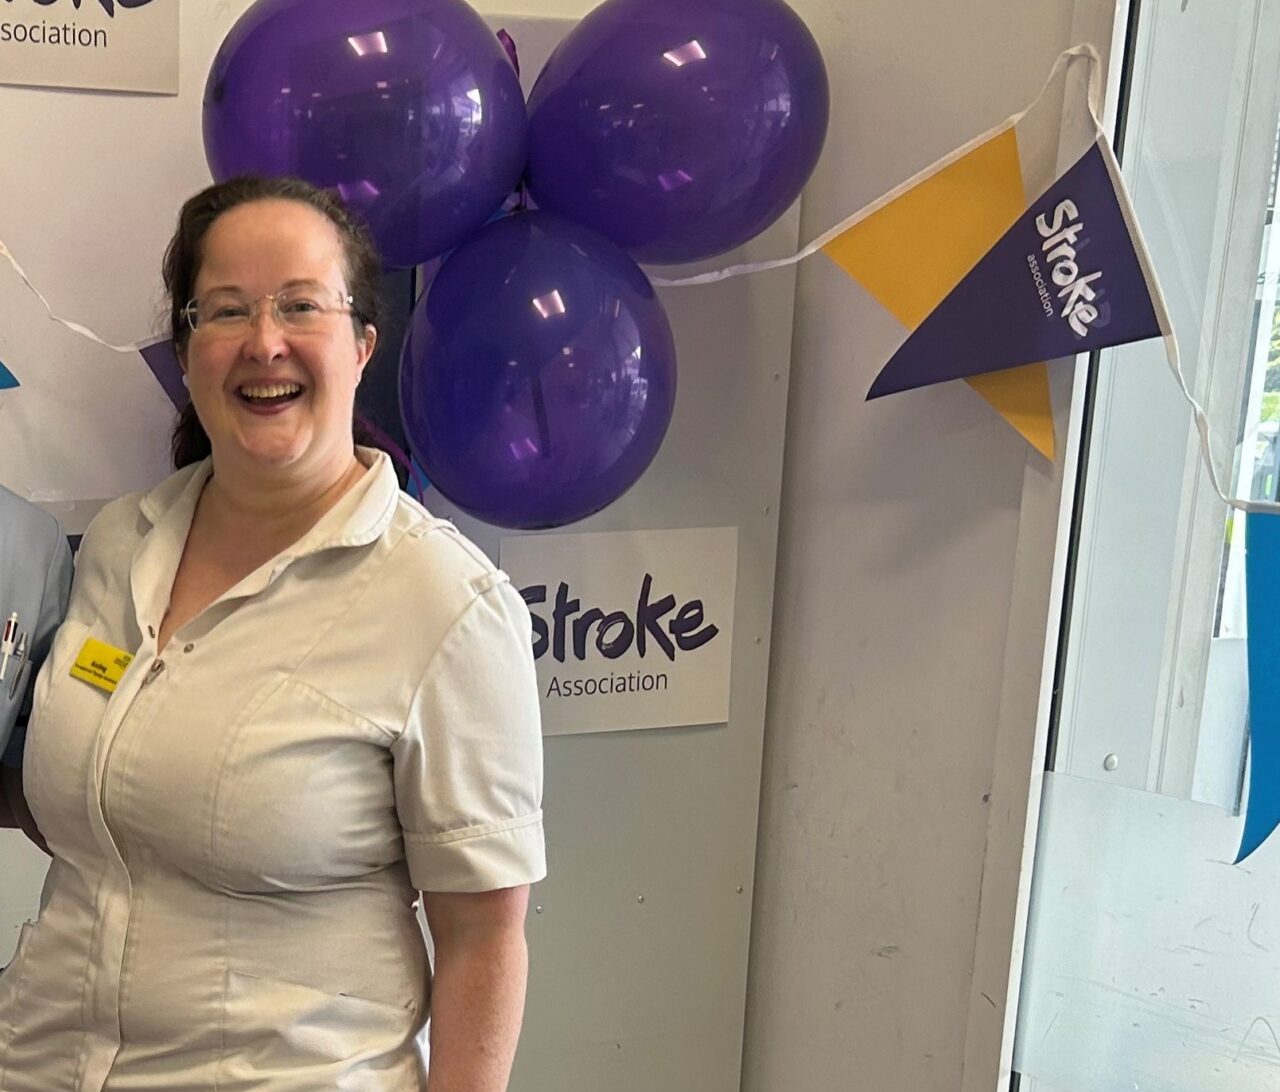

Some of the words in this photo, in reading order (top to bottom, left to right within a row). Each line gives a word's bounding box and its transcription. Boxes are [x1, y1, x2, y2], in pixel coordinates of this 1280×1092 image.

[1027, 253, 1054, 318] association
[1035, 199, 1102, 337] Stroke
[519, 572, 719, 663] Stroke
[546, 670, 668, 698] Association
